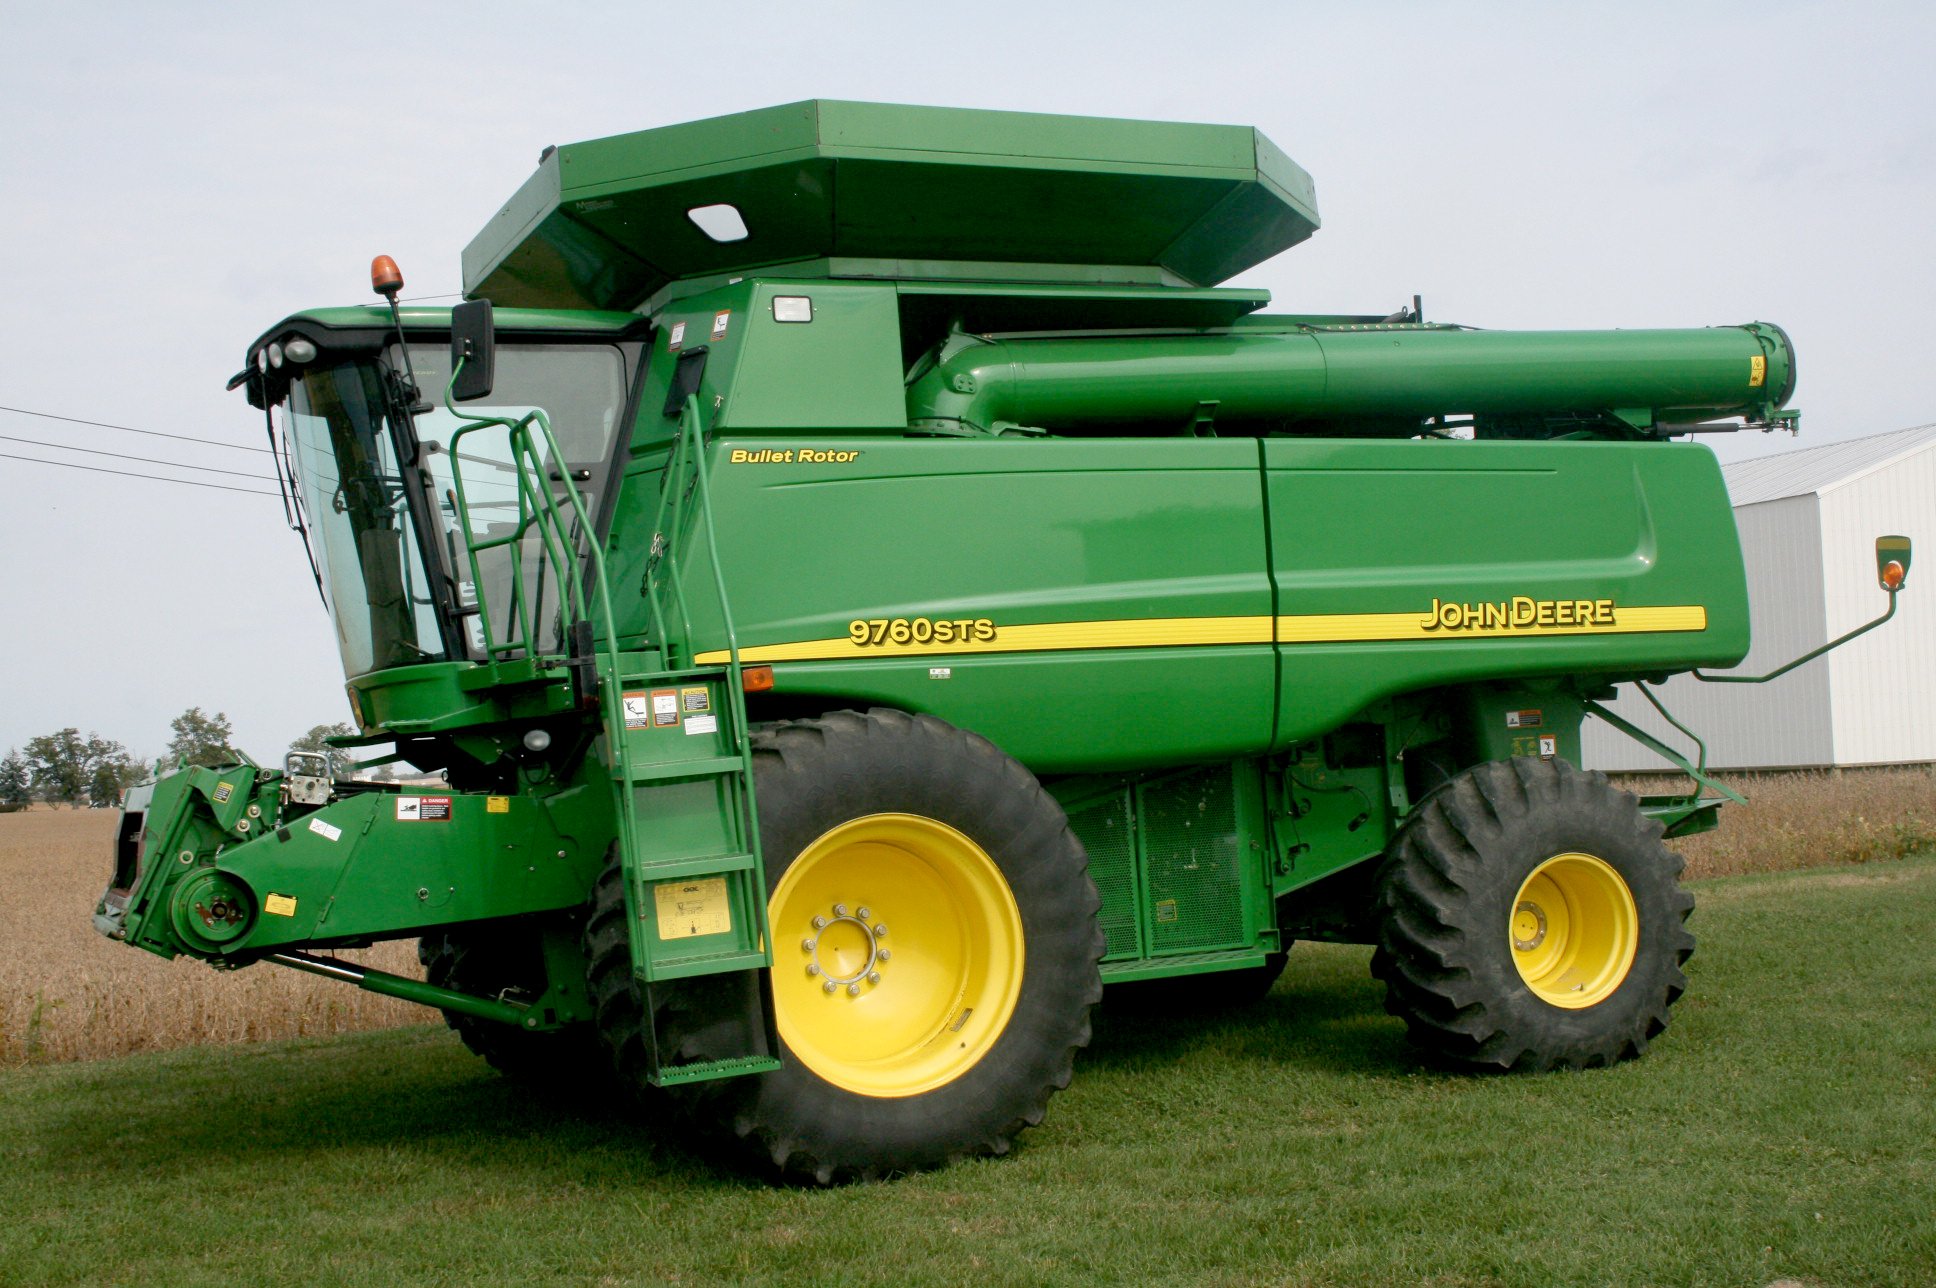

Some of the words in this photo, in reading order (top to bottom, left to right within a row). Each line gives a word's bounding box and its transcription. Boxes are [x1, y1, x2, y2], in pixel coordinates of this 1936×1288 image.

[730, 448, 794, 464] Bullet
[797, 448, 859, 463] Rotor
[1421, 598, 1507, 629] JOHN
[1511, 596, 1614, 626] DEERE
